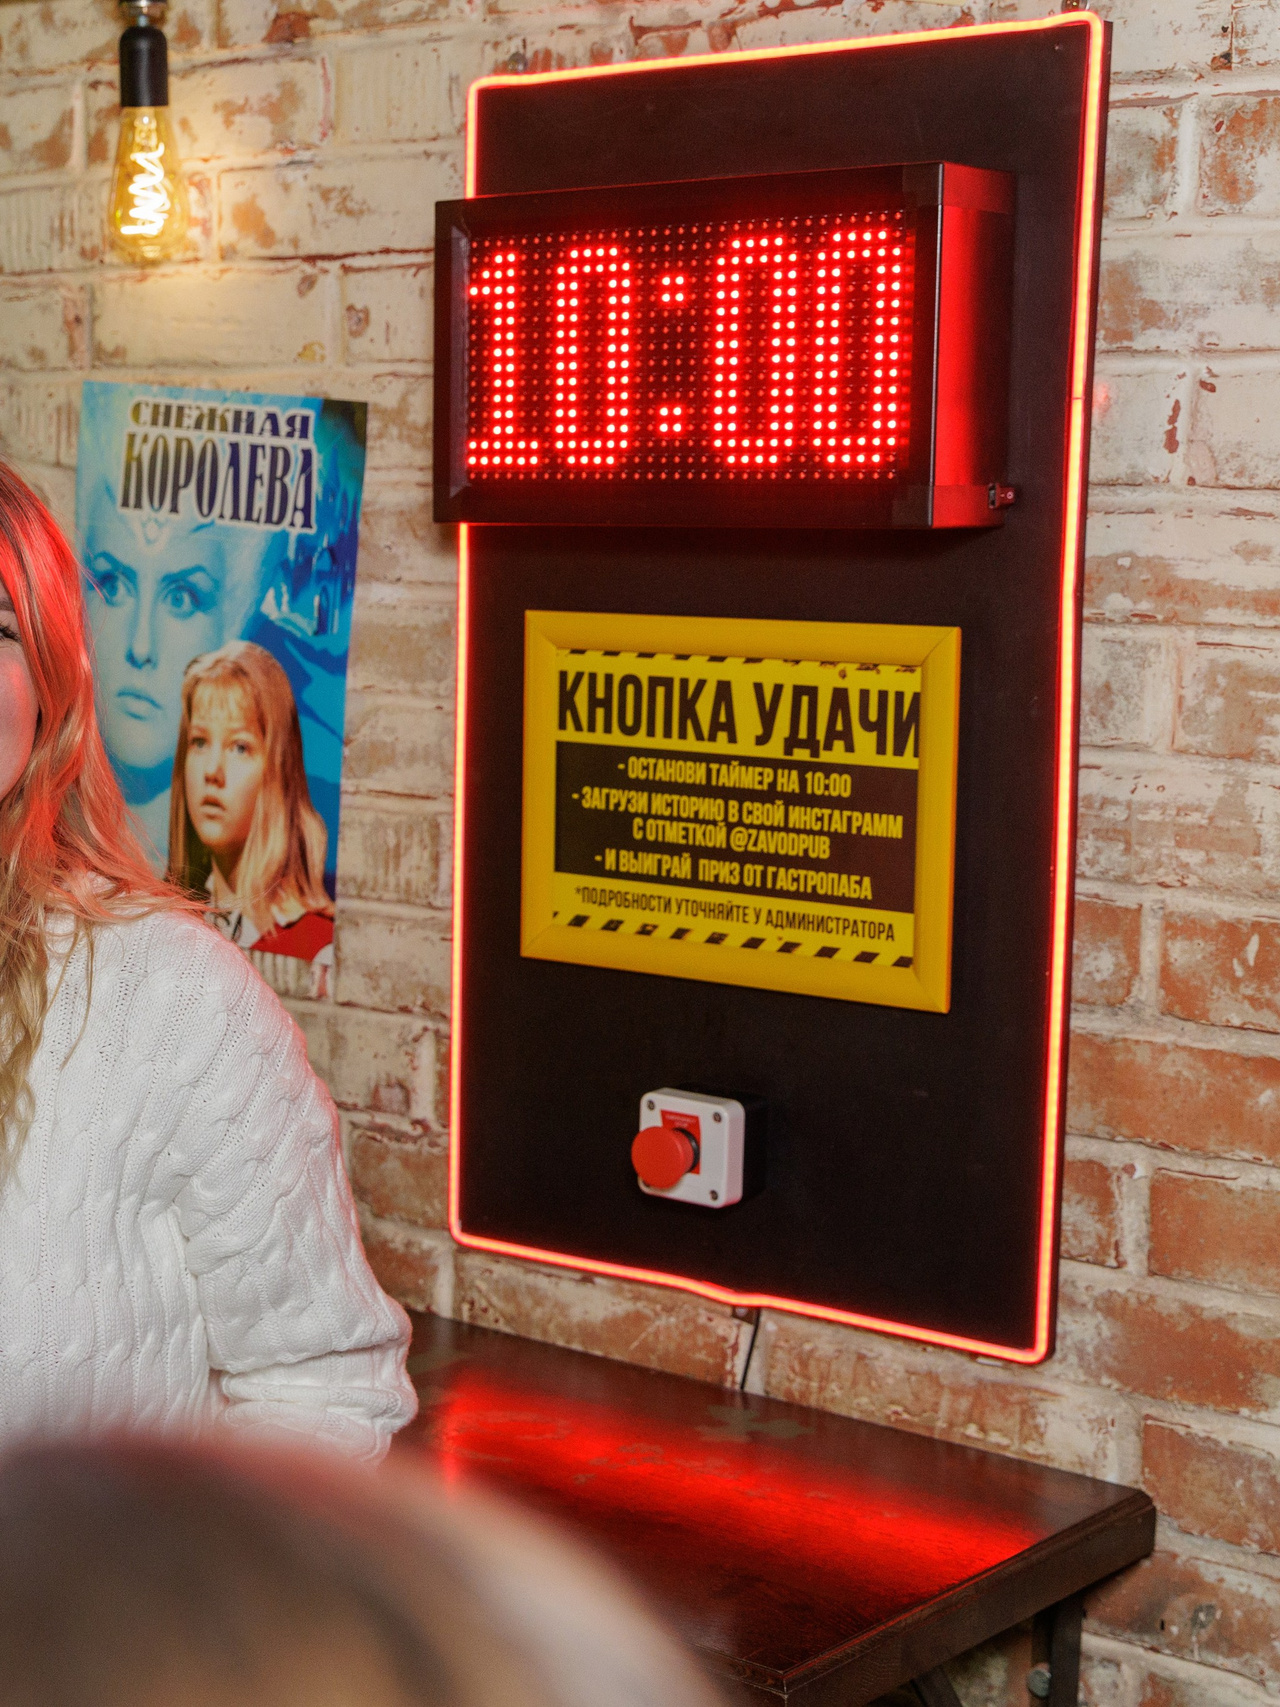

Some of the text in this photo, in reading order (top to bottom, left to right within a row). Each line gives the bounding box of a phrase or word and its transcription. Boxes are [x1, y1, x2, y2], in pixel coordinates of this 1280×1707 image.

[466, 229, 903, 469] 10:00
[130, 400, 312, 440] СНЕЖНАЯ
[120, 431, 314, 530] КОРОЛЕВА
[557, 670, 920, 758] КНОПКА УДАЧИ
[628, 756, 707, 786] ОСТАНОВИ
[709, 761, 774, 791] ТАЙМЕР
[776, 768, 800, 794] НА
[805, 771, 852, 798] 10:00
[581, 785, 649, 814] ЗАГРУЗИ
[651, 792, 725, 822] ИСТОРИЮ
[728, 800, 740, 823] В
[742, 800, 785, 827] СВОЙ
[788, 805, 903, 839] ИНСТАГРАММ
[632, 817, 831, 859] С ОТМЕТКОЙ @ZAVODPUB
[604, 847, 617, 871] И
[619, 849, 692, 880] ВЫИГРАЙ
[698, 858, 740, 885] ПРИЗ
[743, 864, 764, 888] ОТ
[766, 866, 873, 900] ГАСТРОПАБА
[675, 898, 749, 924] УТОЧНЯЙТЕ
[753, 907, 762, 925] У
[765, 909, 895, 942] АДМИНИСТРАТОРА
